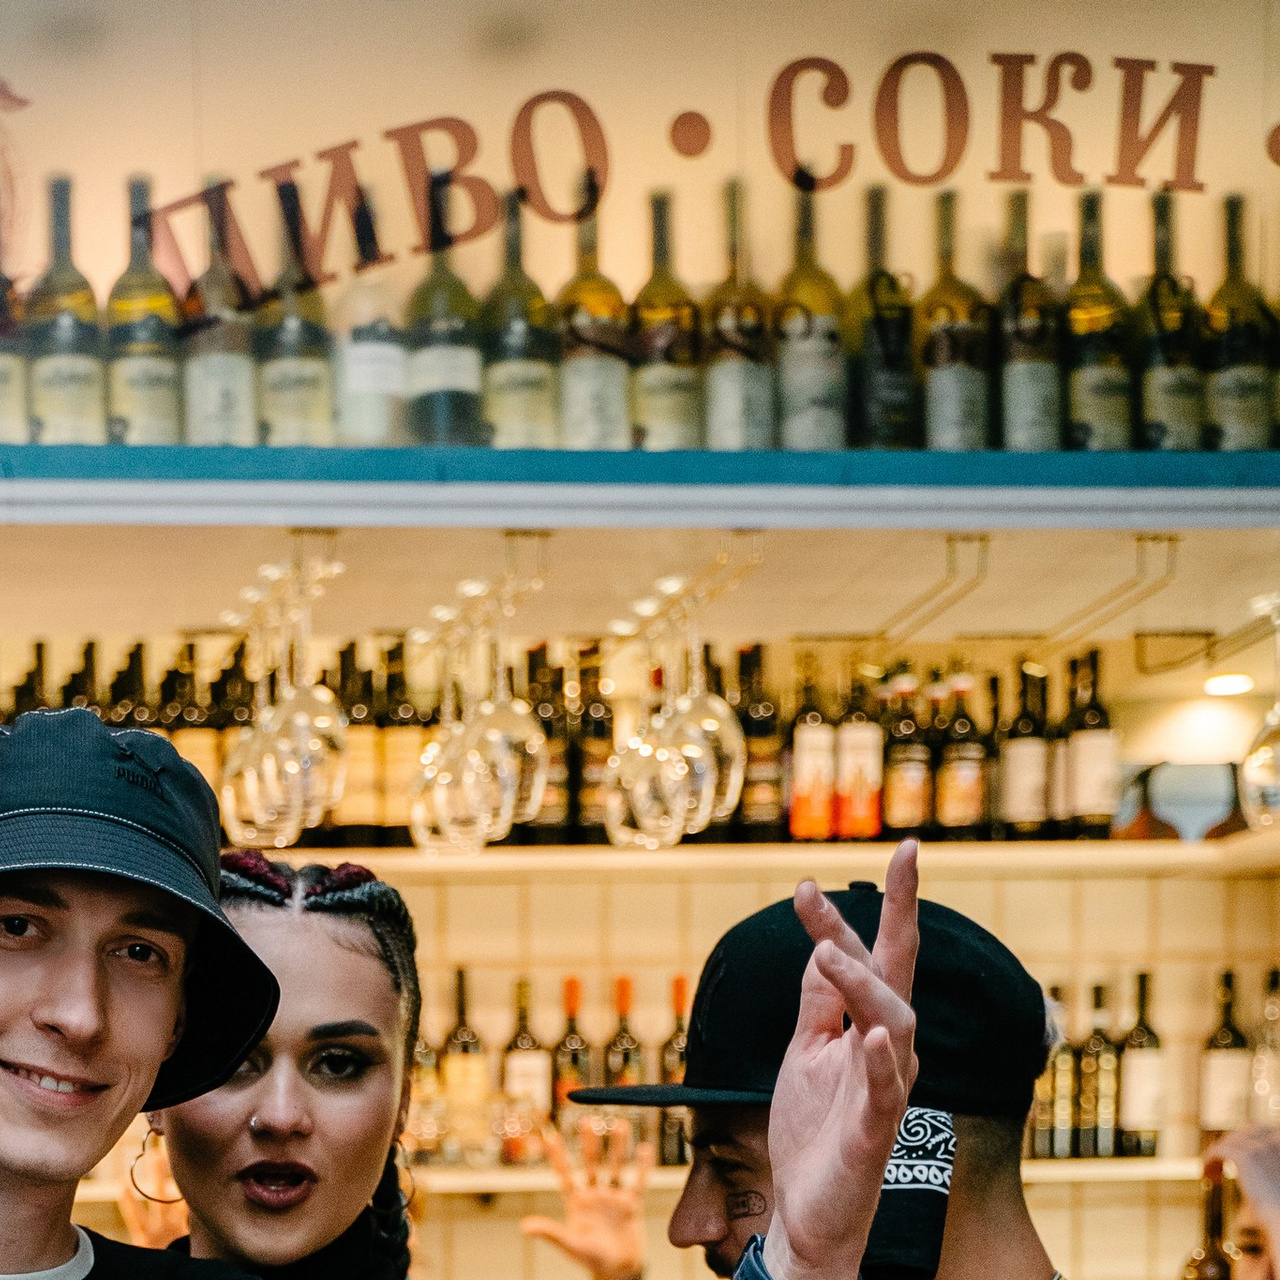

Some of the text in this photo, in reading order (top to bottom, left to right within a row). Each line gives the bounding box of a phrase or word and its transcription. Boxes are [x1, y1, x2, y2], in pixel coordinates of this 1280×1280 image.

[149, 90, 612, 310] ПИВО
[767, 51, 1216, 193] СОКИ
[115, 764, 158, 793] PUMA
